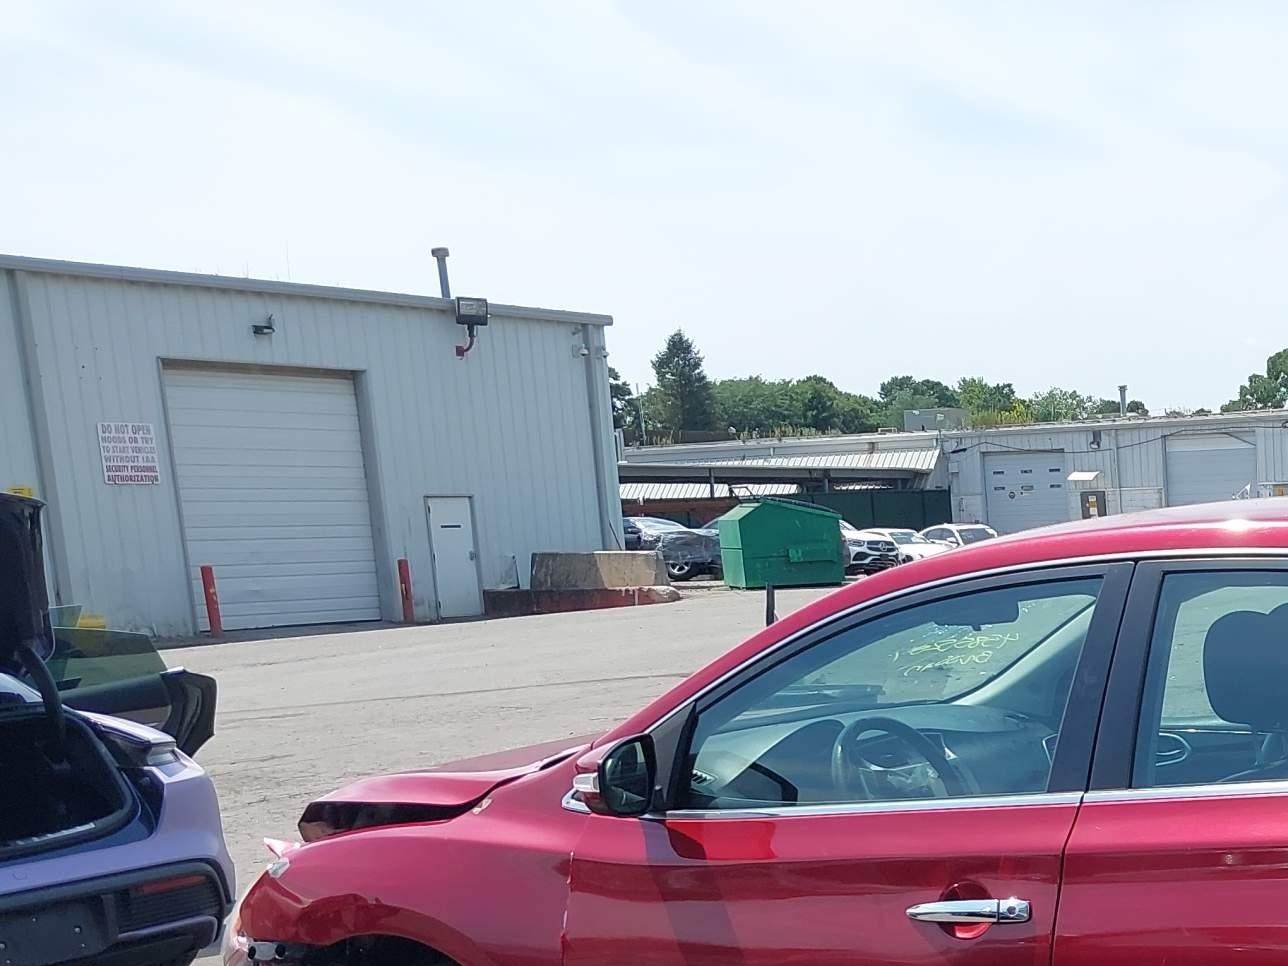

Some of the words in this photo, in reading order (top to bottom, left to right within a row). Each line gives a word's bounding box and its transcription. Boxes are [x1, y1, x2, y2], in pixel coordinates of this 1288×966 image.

[101, 423, 113, 435] DO
[114, 424, 129, 435] NOT
[131, 424, 151, 436] OPEN
[128, 436, 139, 445] OR
[102, 445, 111, 454] TO
[103, 455, 139, 464] WITHOUT
[105, 464, 129, 473] SECURITY
[107, 474, 159, 483] AUTHORIZATION
